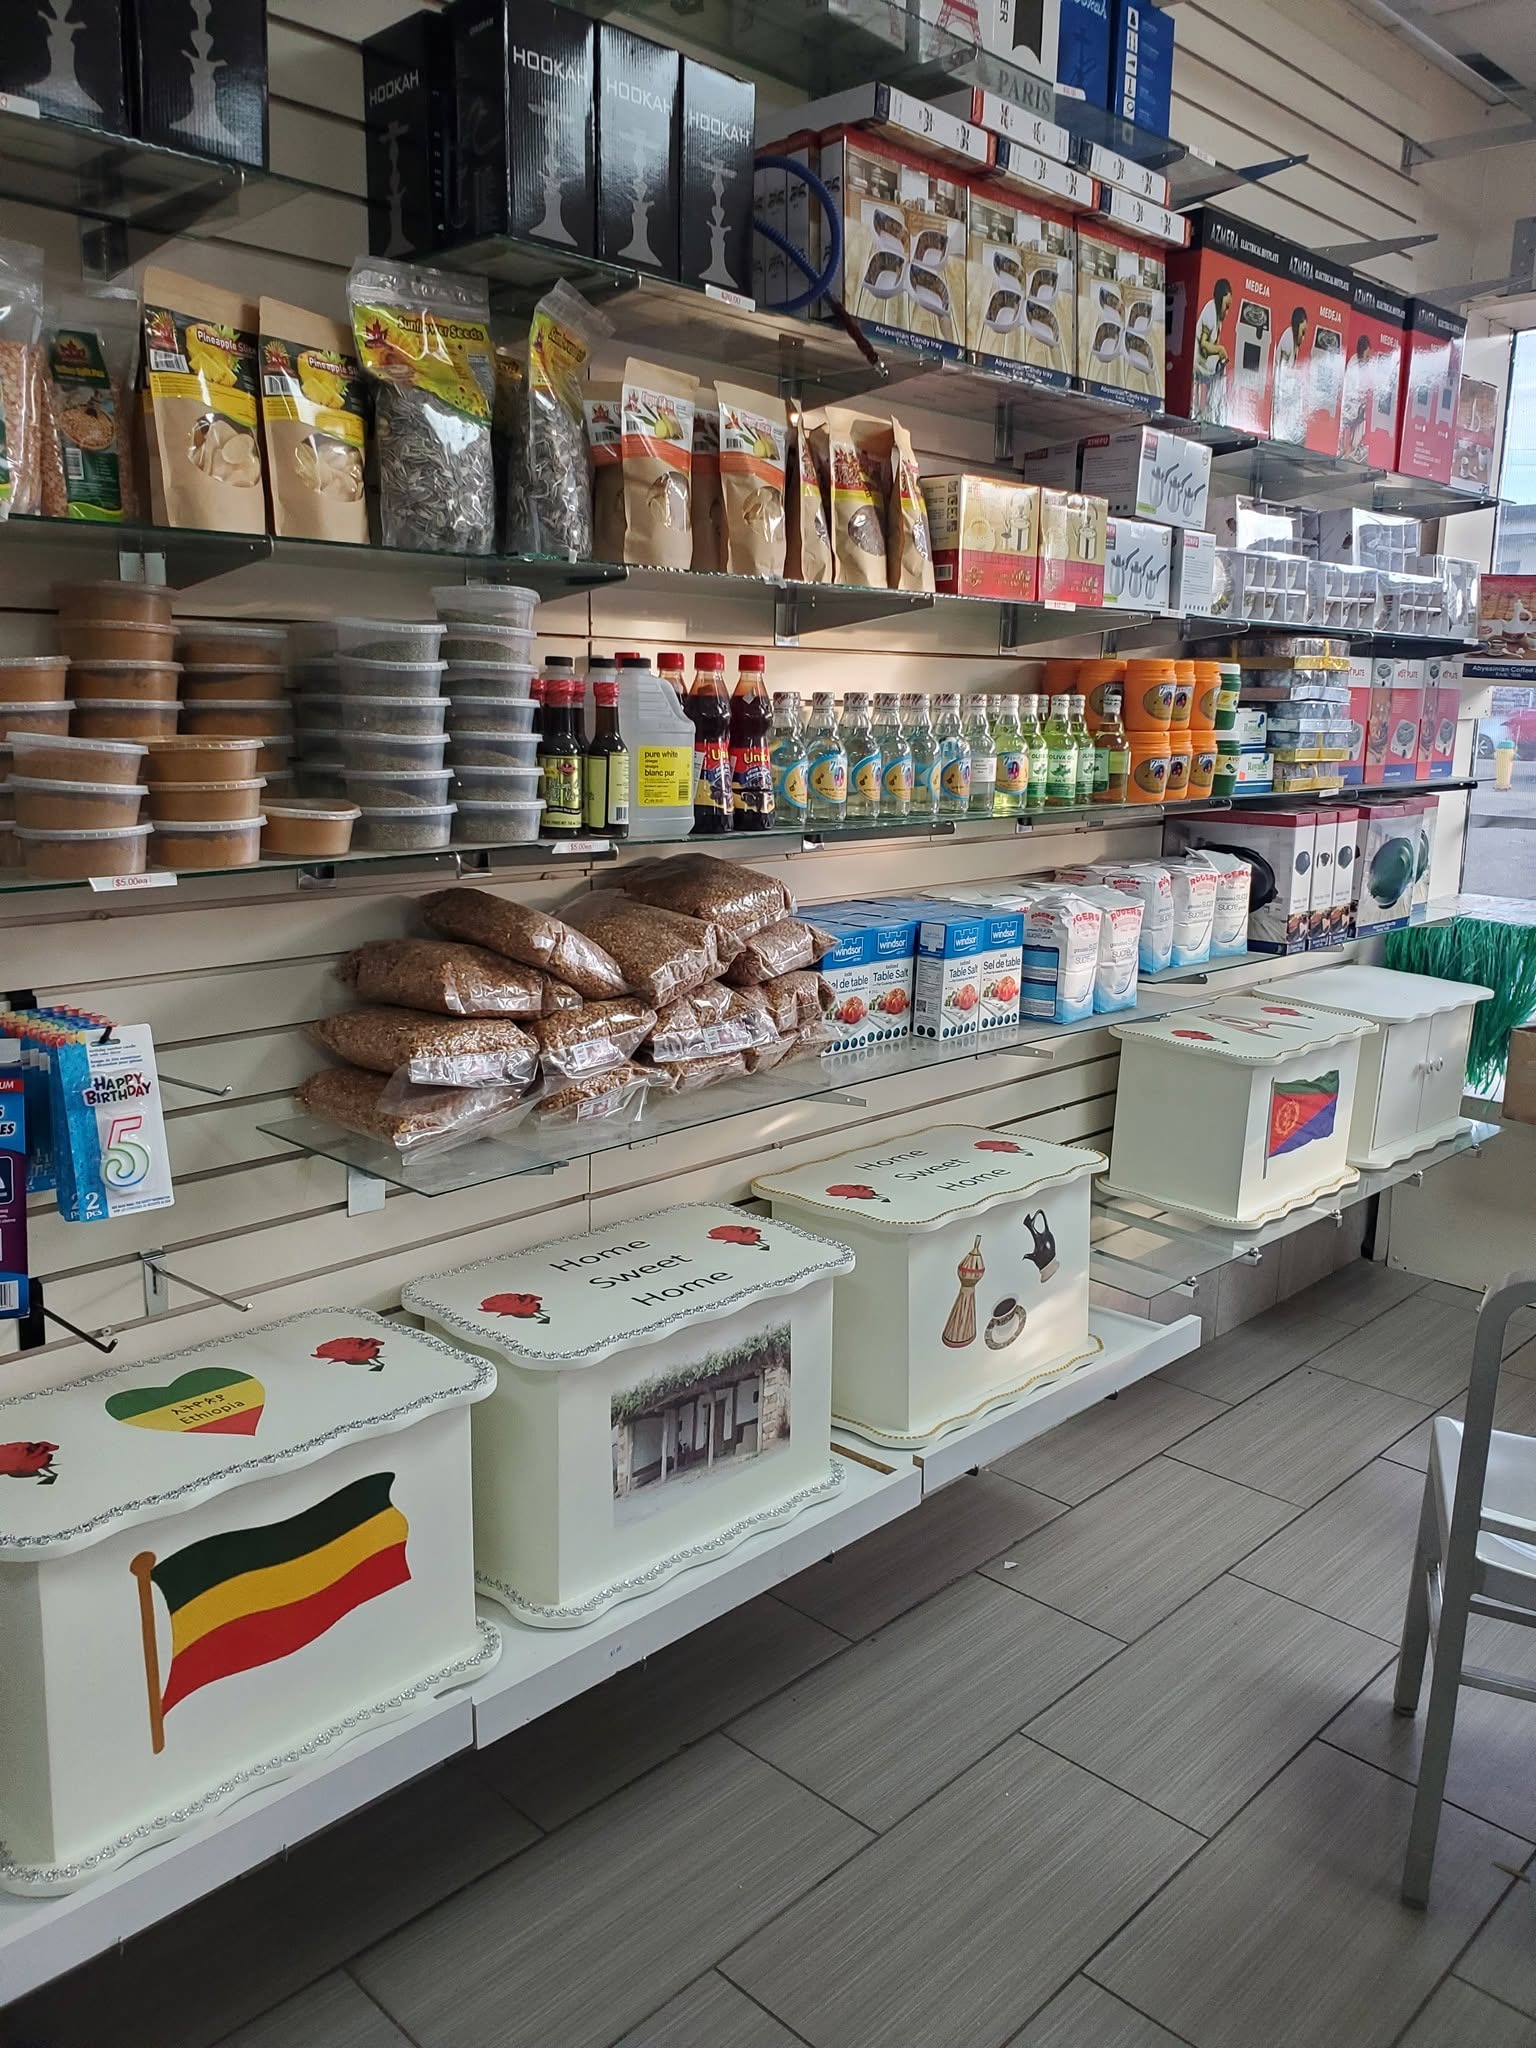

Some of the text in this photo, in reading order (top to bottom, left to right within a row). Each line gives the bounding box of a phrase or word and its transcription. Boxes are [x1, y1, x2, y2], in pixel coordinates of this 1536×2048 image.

[513, 45, 587, 87] HOOKAH
[369, 69, 420, 107] HOOKAH
[606, 77, 673, 117] HOOKAH
[997, 69, 1051, 114] PARIS
[689, 108, 750, 147] HOOKAH
[1210, 223, 1239, 250] AZMERA
[1289, 256, 1314, 280] AZMERA
[1245, 278, 1270, 298] MEDEJA
[1319, 305, 1341, 323] MEDEJA
[197, 329, 237, 350] Pineapple
[450, 324, 484, 341] Seeds
[910, 334, 931, 348] Candy
[931, 340, 943, 351] tray
[308, 355, 347, 374] Pineapple
[644, 750, 679, 759] pure white
[644, 768, 676, 778] blanc pur
[115, 877, 148, 887] $5.00ea
[879, 936, 906, 949] windsor
[955, 935, 977, 946] windsor
[992, 928, 1016, 939] windsor
[835, 945, 862, 957] windsor
[949, 968, 967, 979] Table
[967, 964, 978, 976] Salt
[983, 957, 1021, 970] Sel de table
[839, 978, 850, 989] de
[850, 974, 869, 987] table
[873, 967, 909, 982] Table Salt
[93, 1071, 143, 1091] HAPPY
[84, 1081, 152, 1105] BIRTHDAY
[104, 1115, 150, 1188] 5
[855, 1149, 929, 1171] Home
[894, 1158, 971, 1181] Sweet
[937, 1168, 1012, 1192] Home
[85, 1191, 100, 1211] 2
[86, 1209, 103, 1220] pcs
[549, 1239, 652, 1272] Home
[588, 1253, 694, 1289] Sweet
[630, 1270, 734, 1307] Home
[179, 1400, 246, 1425] Ethiopia
